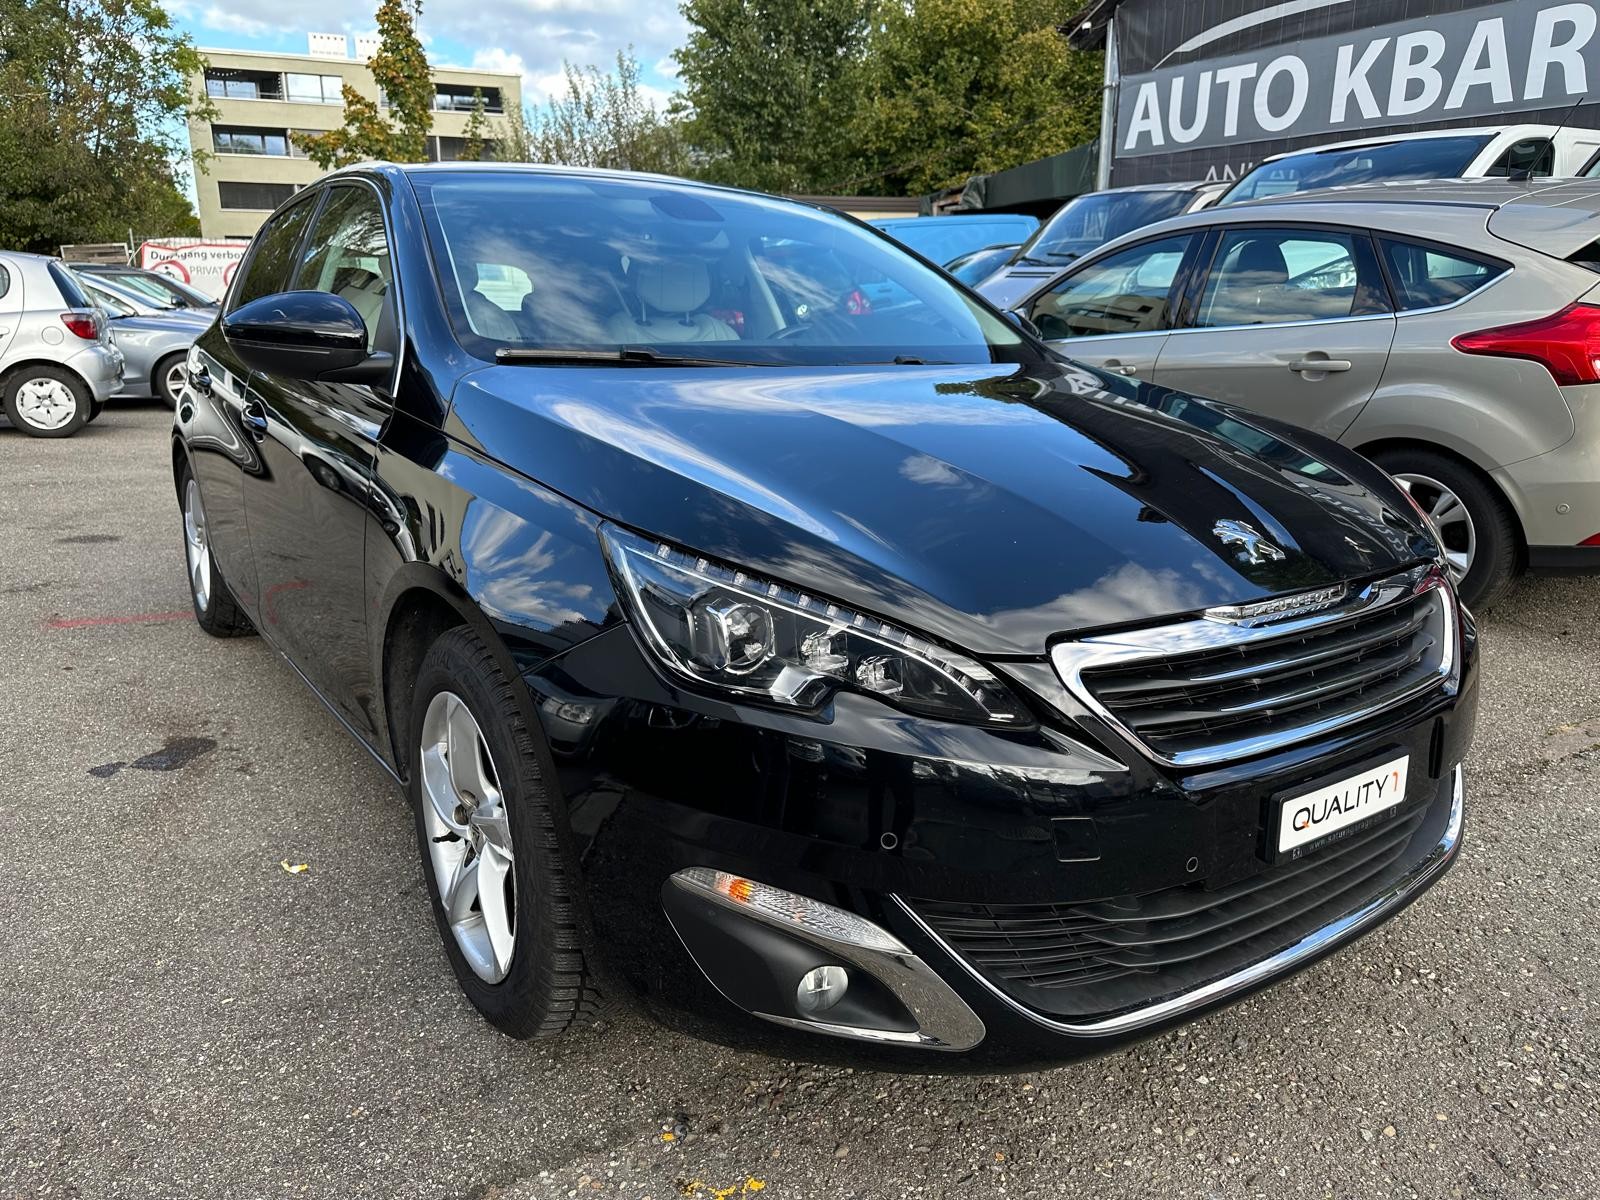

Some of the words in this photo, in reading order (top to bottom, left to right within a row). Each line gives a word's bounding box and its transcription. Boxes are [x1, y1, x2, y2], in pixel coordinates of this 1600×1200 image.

[1123, 54, 1309, 151] AUTO
[1329, 2, 1598, 124] KBAR
[189, 265, 223, 276] PRIVAT
[1292, 774, 1389, 832] QUALITY
[1392, 770, 1399, 793] 1
